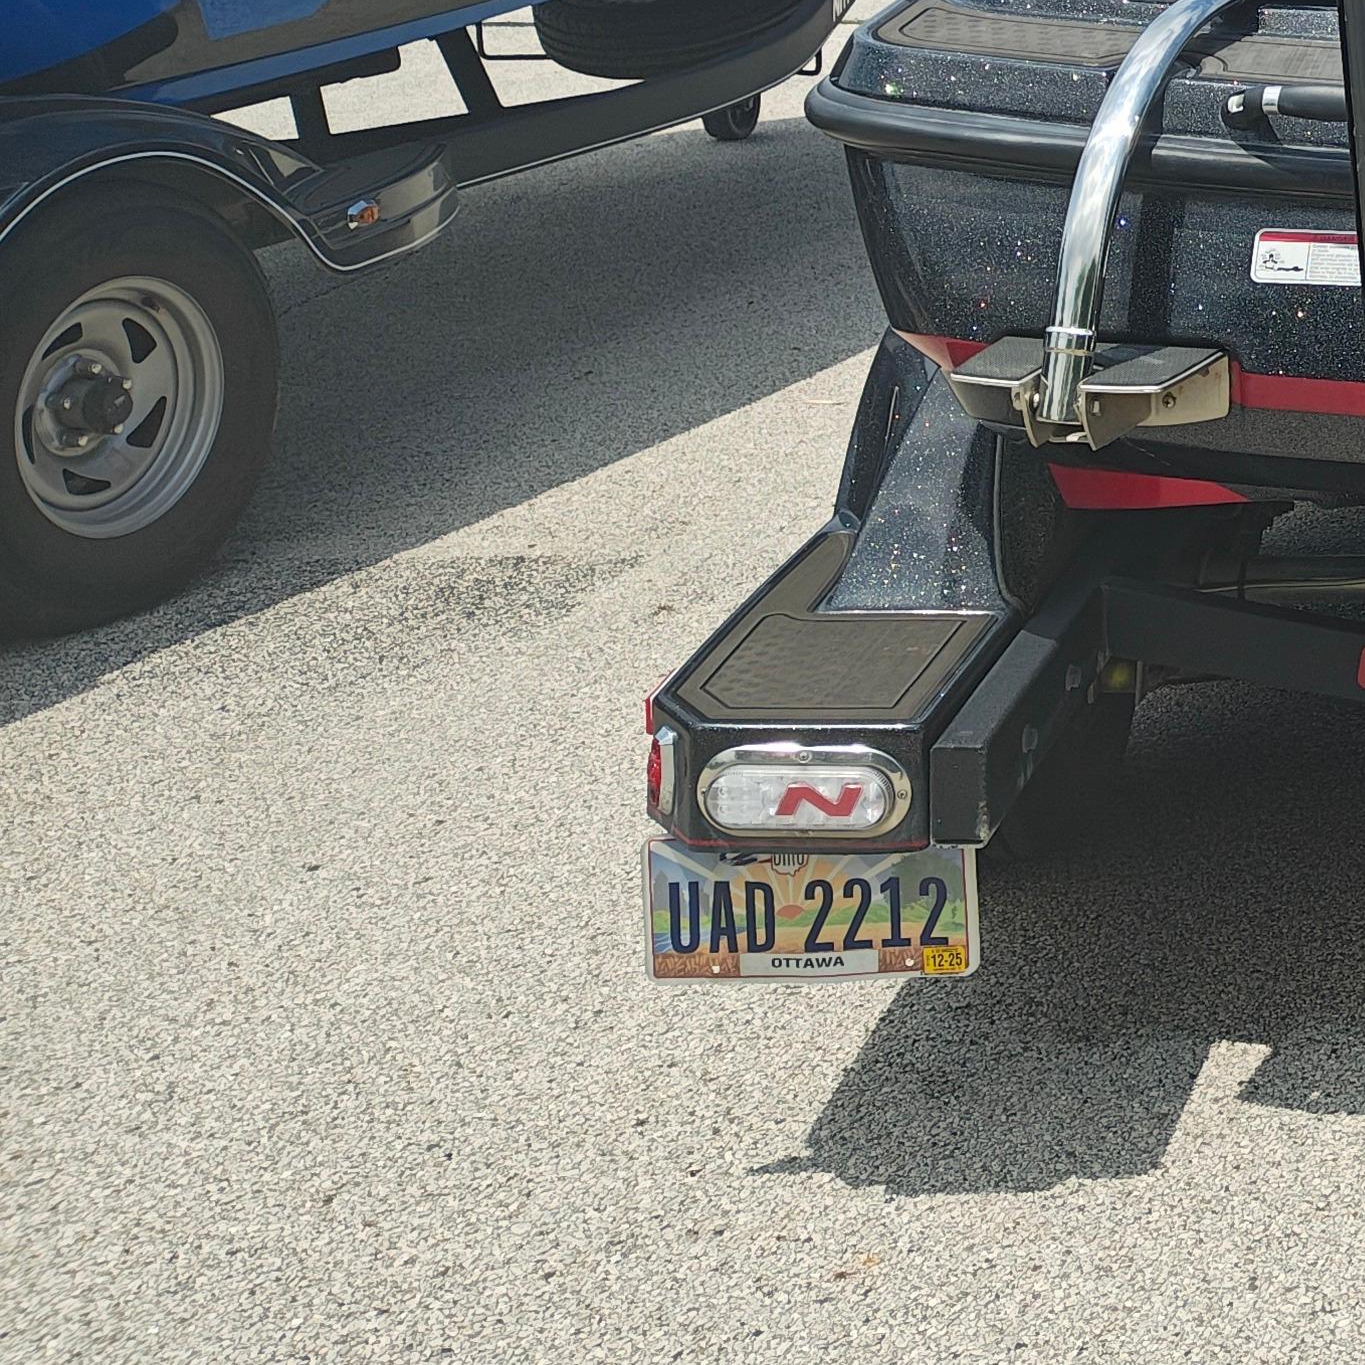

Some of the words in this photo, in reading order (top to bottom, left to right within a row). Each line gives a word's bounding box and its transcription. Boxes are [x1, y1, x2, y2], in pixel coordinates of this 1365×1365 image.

[668, 880, 776, 954] UAD
[803, 876, 949, 952] 2212
[771, 955, 846, 969] OTTAWA
[930, 952, 963, 968] 12-25
